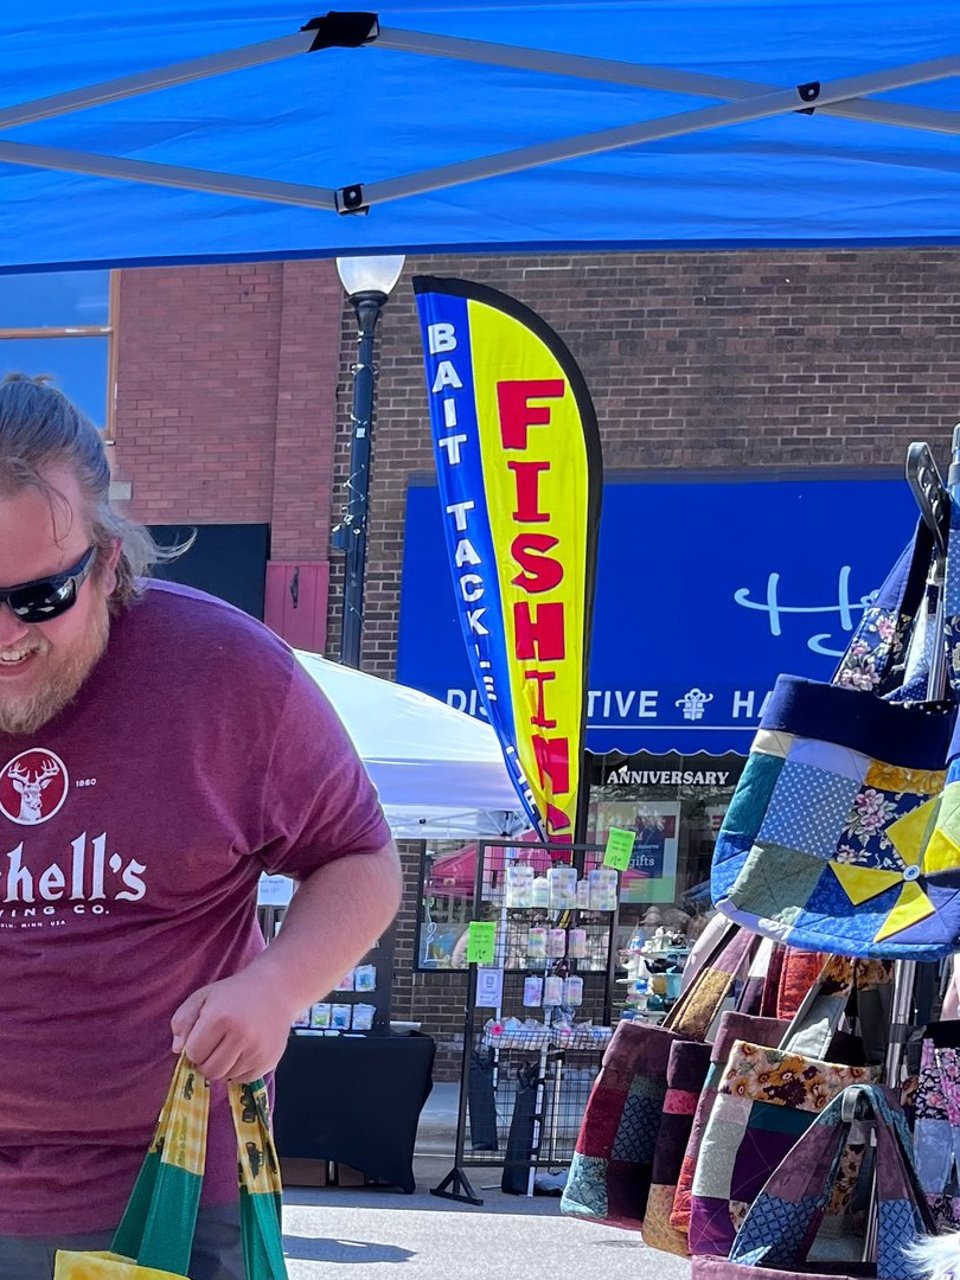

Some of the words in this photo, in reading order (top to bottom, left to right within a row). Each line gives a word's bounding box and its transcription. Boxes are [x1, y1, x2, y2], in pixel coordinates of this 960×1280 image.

[427, 322, 468, 465] BAIT
[607, 770, 730, 785] ANNIVERSARY
[73, 904, 110, 915] CO.
